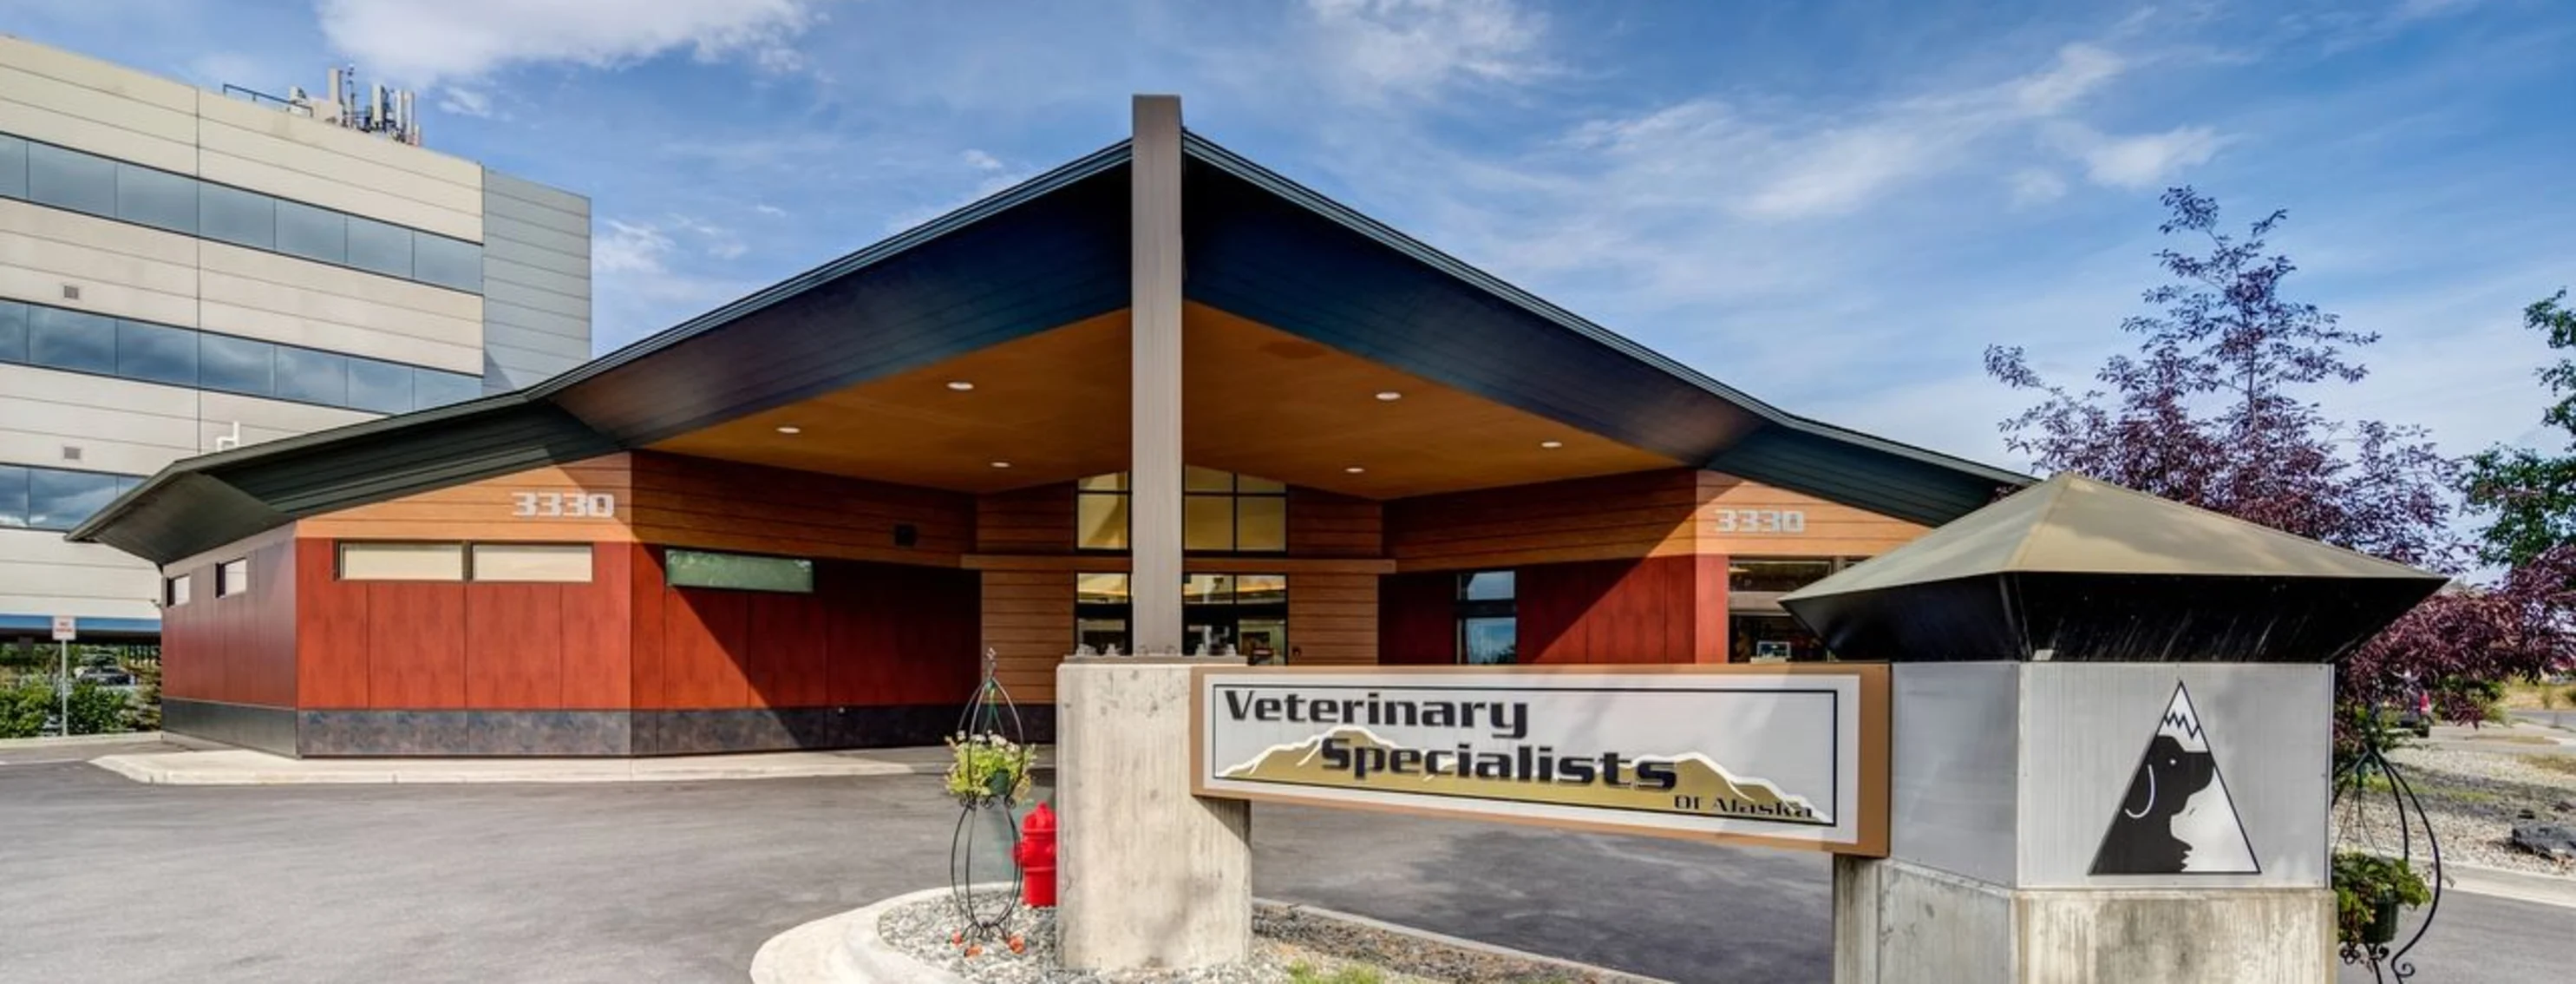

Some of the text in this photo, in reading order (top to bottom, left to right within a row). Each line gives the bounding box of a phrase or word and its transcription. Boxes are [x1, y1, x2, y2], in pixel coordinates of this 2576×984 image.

[510, 491, 614, 518] 3330
[1715, 508, 1805, 533] 3330
[1224, 690, 1528, 739] Veterinary
[1321, 737, 1677, 791] Specialists
[1713, 797, 1813, 818] Alaska
